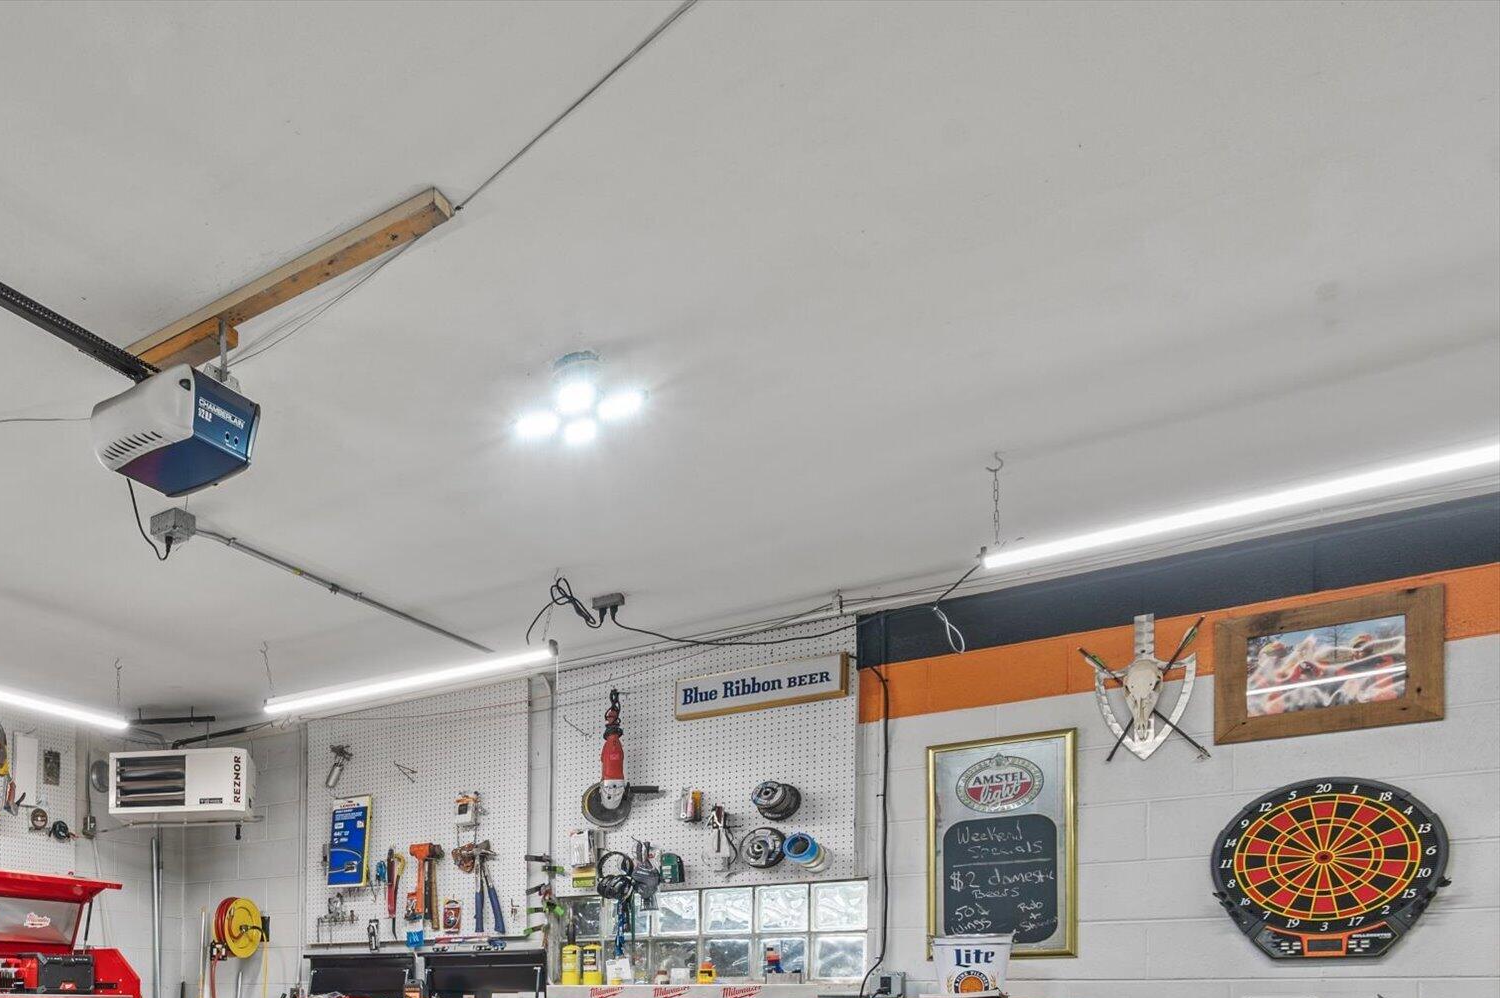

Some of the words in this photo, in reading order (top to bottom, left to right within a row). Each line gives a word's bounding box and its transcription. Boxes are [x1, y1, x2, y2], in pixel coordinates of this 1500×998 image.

[681, 687, 718, 706] Blue
[722, 676, 783, 699] Ribbon
[786, 670, 832, 689] BEER
[233, 755, 241, 804] REZNOR
[972, 771, 1028, 786] AMSTEL
[1315, 783, 1332, 793] 20
[1350, 785, 1358, 794] 1
[979, 780, 1022, 807] light
[1288, 791, 1297, 800] 5
[1379, 791, 1392, 801] 18
[1258, 802, 1272, 813] 12
[1403, 805, 1413, 815] 4
[1241, 819, 1250, 828] 9
[1418, 823, 1431, 833] 13
[1224, 838, 1236, 848] 14
[1425, 845, 1436, 855] 6
[1219, 859, 1232, 869] 11
[1416, 867, 1431, 878] 10
[1227, 879, 1236, 888] 8
[1402, 889, 1417, 899] 15
[1240, 898, 1250, 906] 16
[1263, 911, 1271, 920] 7
[1381, 906, 1390, 915] 2
[1285, 918, 1300, 928] 19
[1319, 922, 1328, 931] 3
[1347, 916, 1364, 927] 17
[955, 948, 995, 968] Lite
[722, 985, 762, 998] Milwaukee
